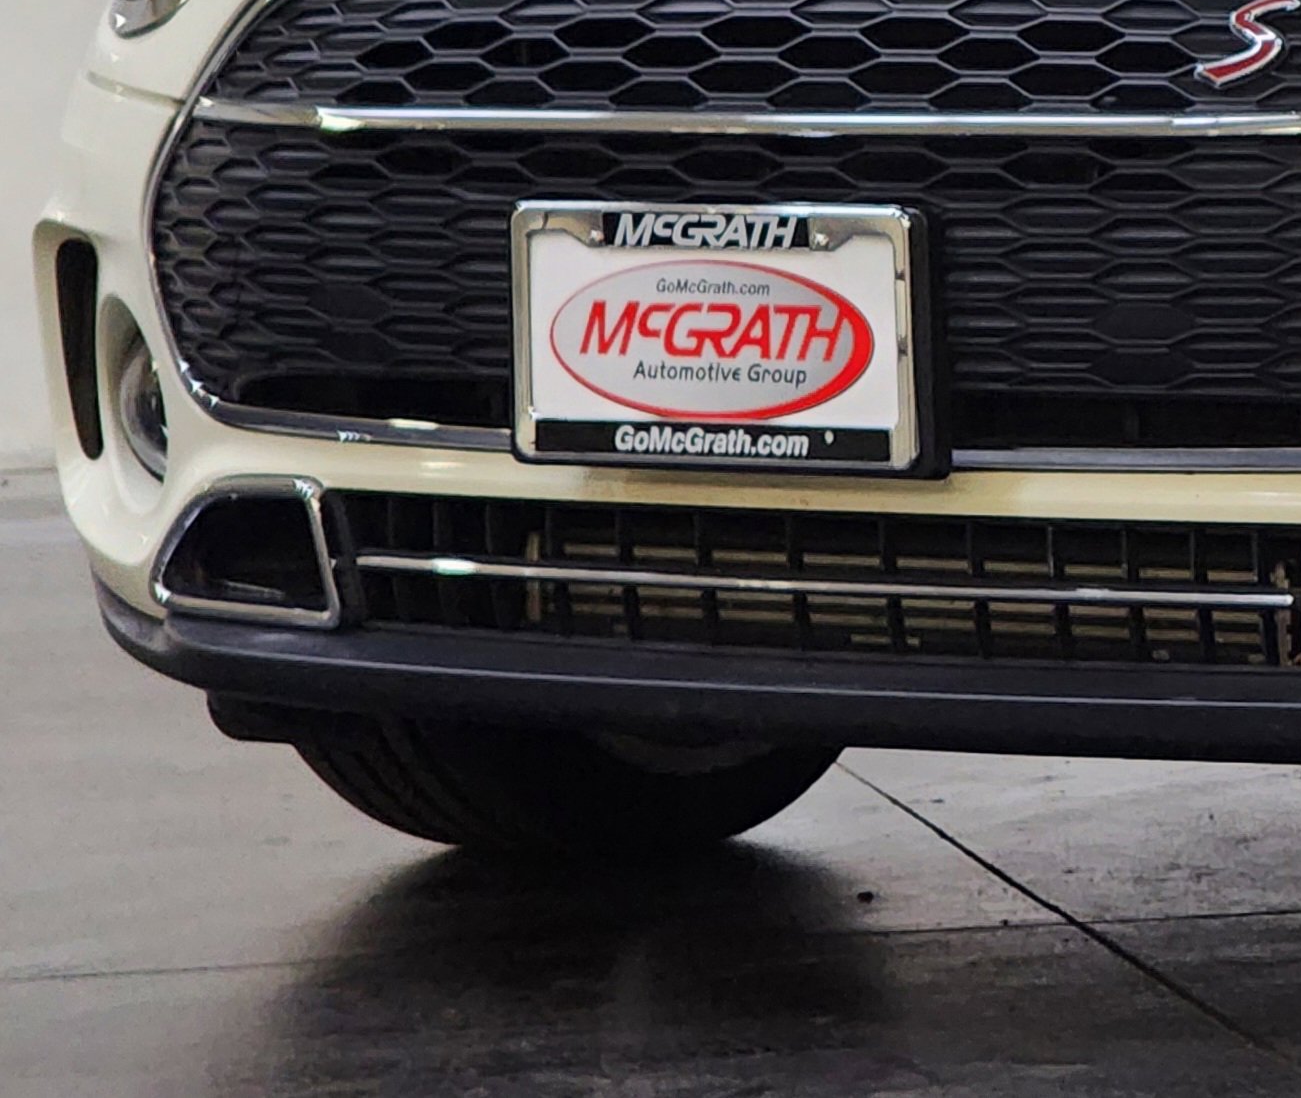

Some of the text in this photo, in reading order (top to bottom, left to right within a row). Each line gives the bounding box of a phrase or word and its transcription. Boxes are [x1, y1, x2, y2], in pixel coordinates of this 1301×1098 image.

[656, 278, 770, 296] GoMcGrath.com
[633, 360, 807, 389] Automotive Group
[614, 425, 810, 457] GoMcGrath.com
